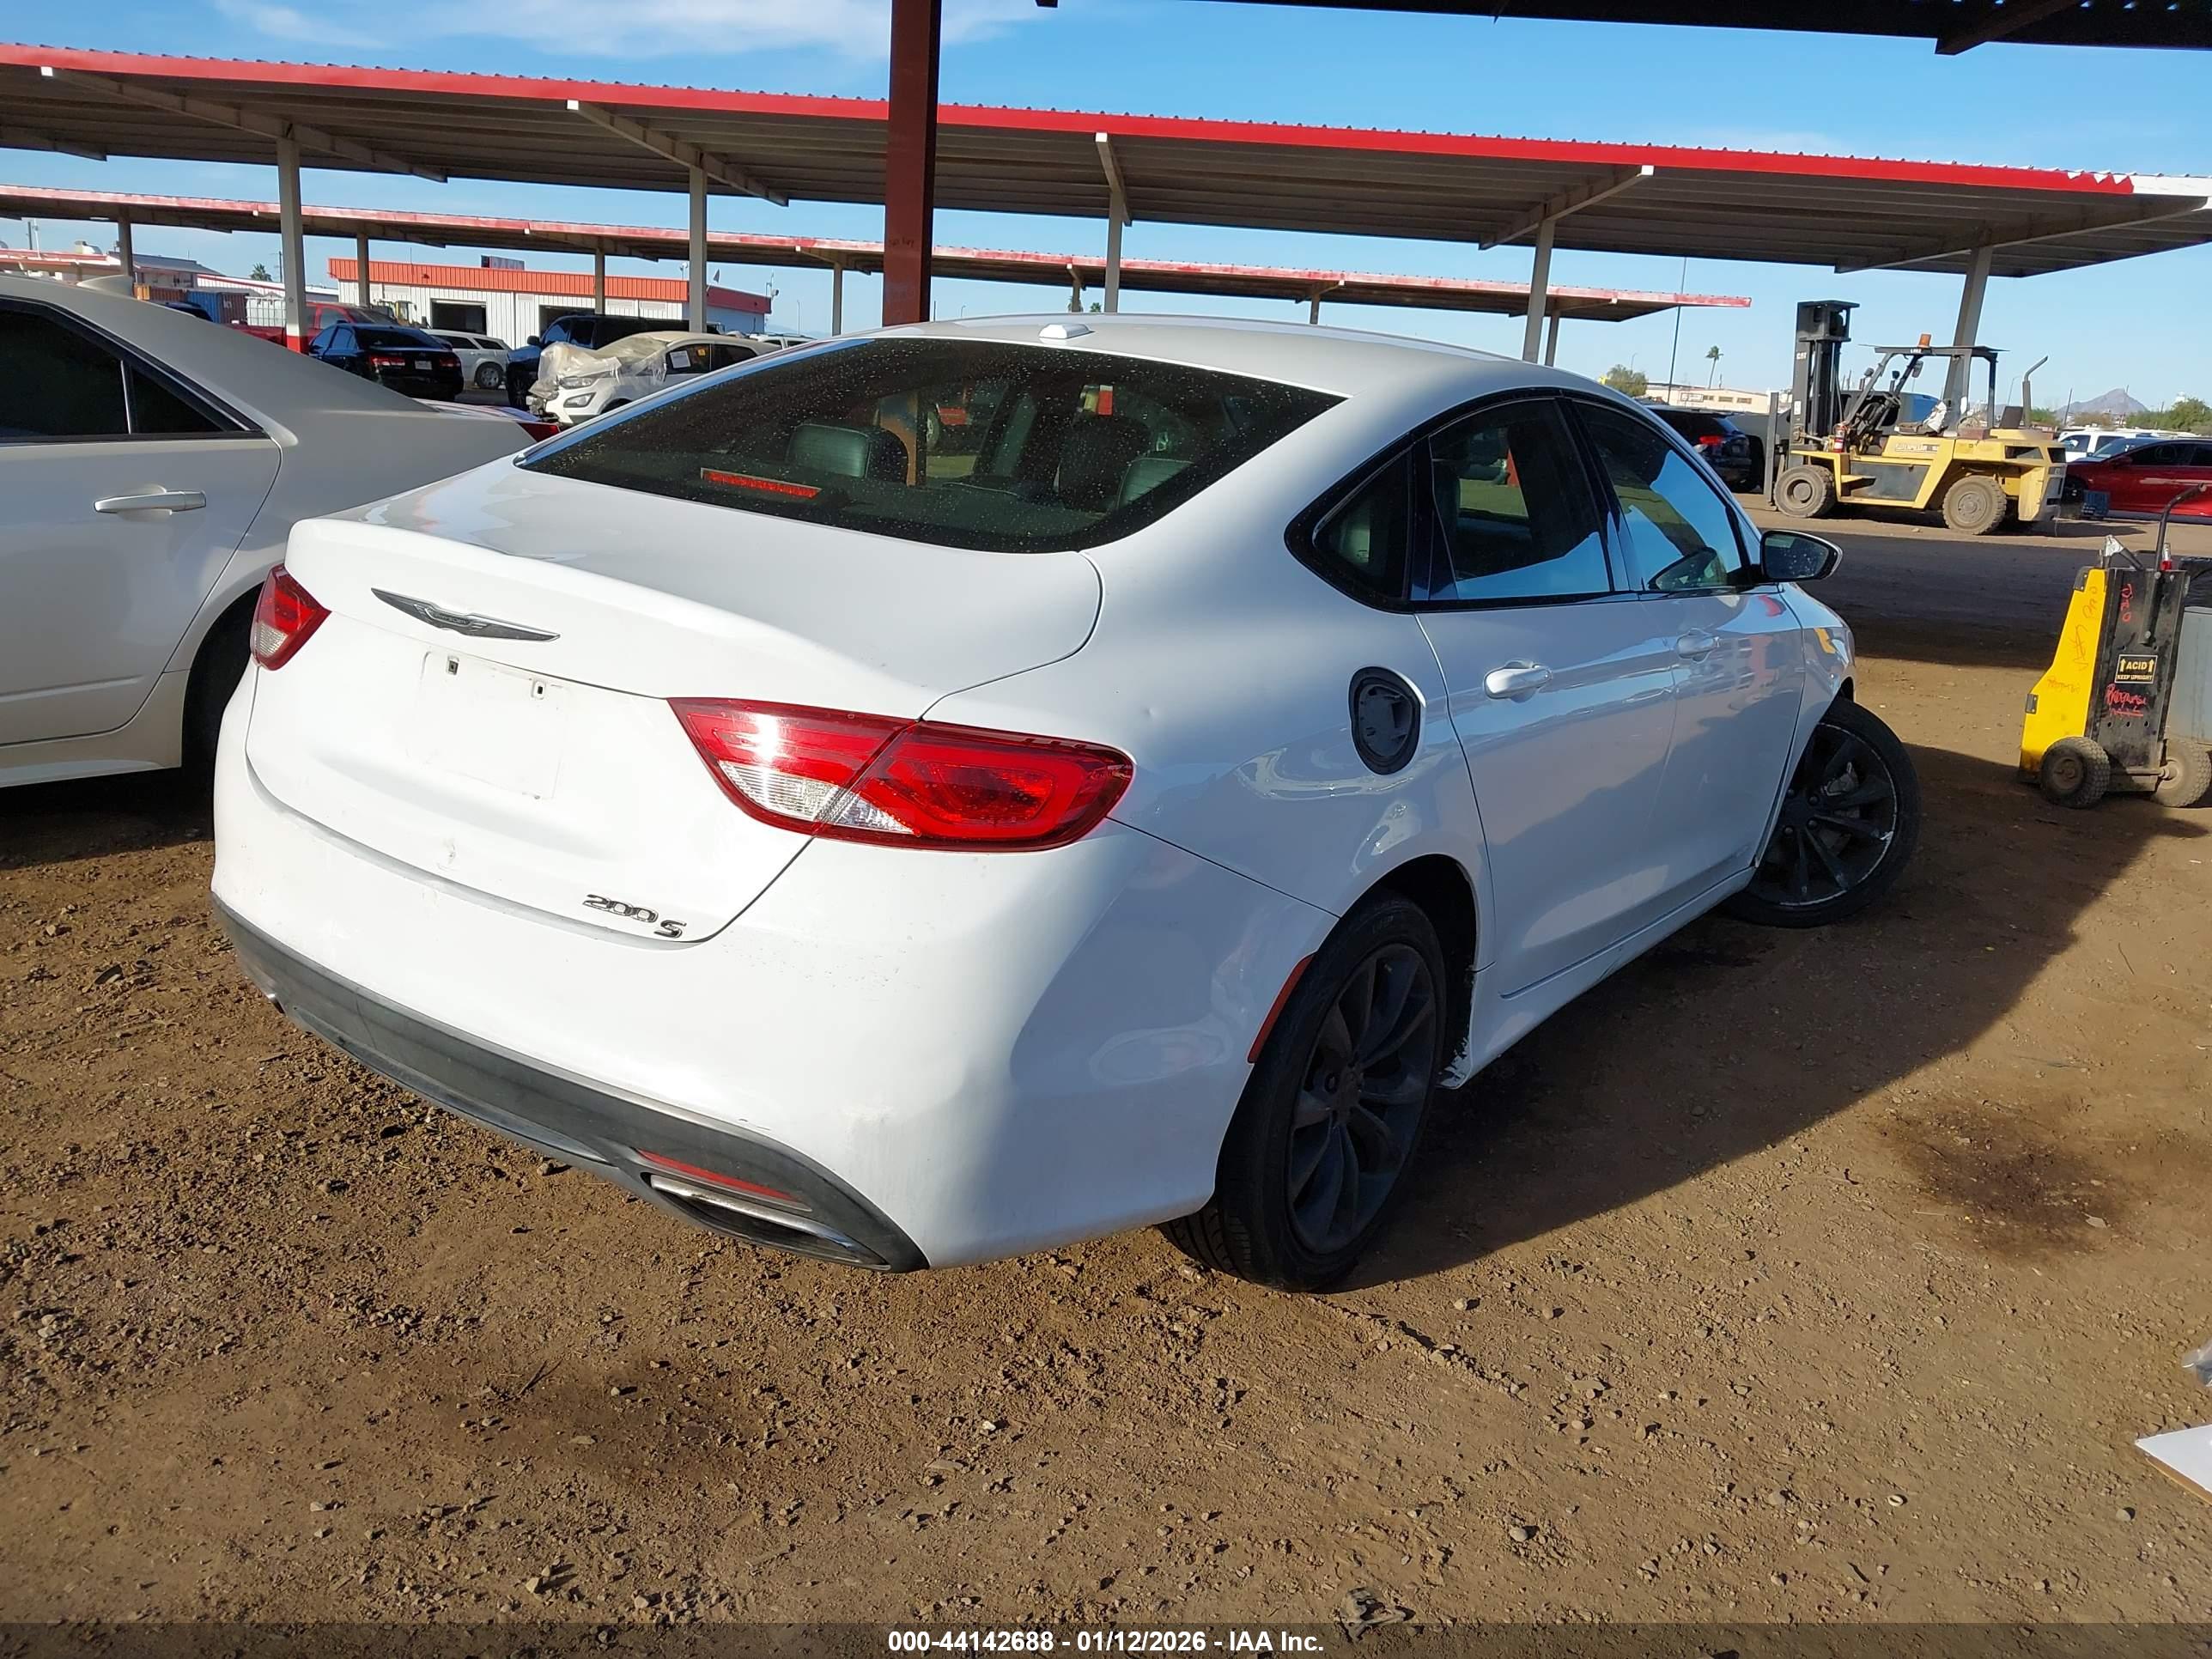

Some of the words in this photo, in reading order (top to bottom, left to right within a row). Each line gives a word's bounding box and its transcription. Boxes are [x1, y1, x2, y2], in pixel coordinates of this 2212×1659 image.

[2125, 660, 2148, 671] ACID
[582, 894, 659, 924] 200
[653, 919, 687, 939] S
